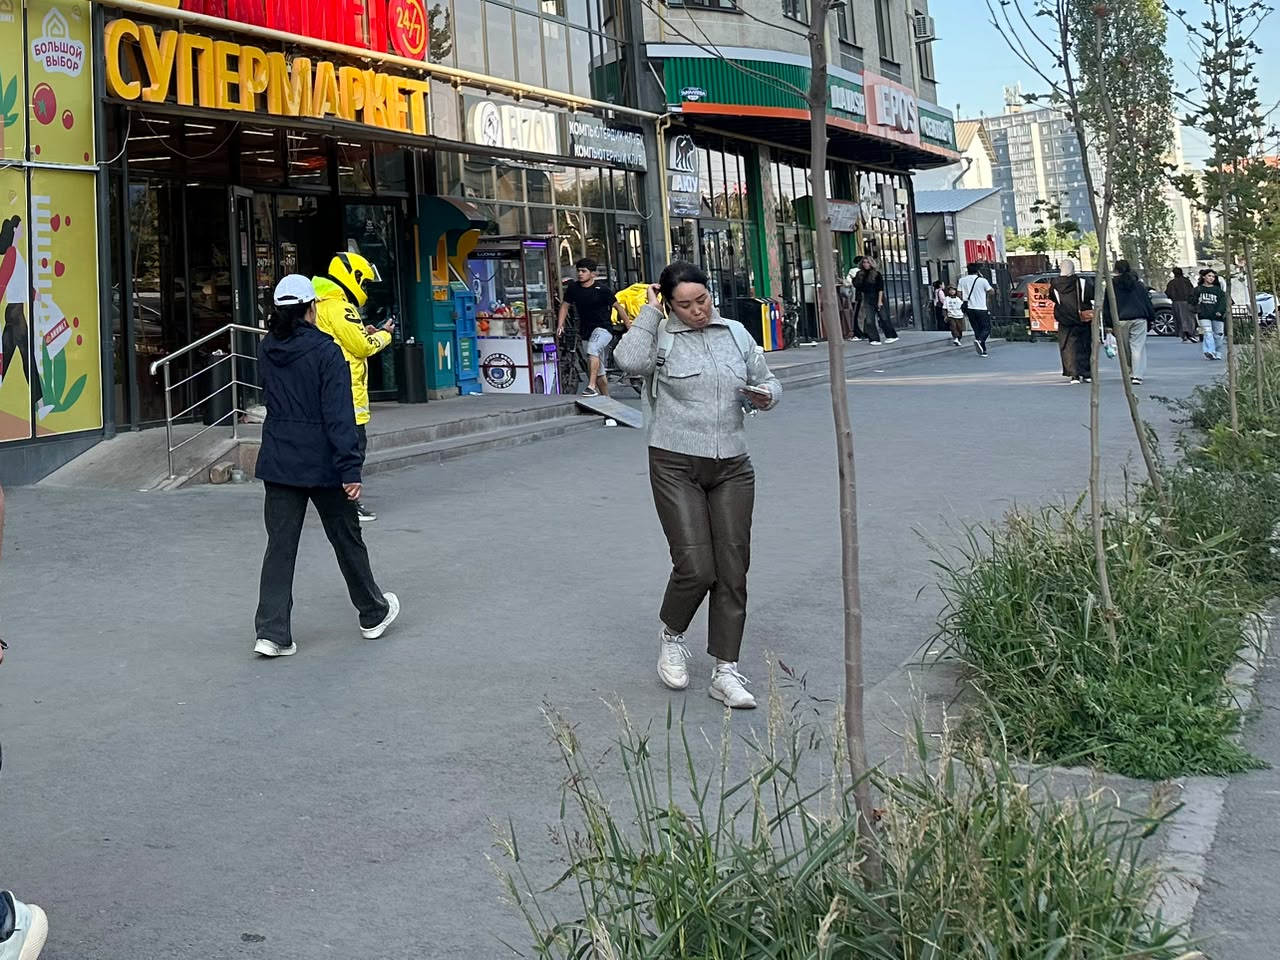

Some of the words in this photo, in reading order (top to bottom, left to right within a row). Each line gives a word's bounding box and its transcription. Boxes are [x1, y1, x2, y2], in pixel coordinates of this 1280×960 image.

[396, 6, 421, 45] 24/7
[34, 41, 83, 61] БОЛЬШОЙ
[45, 55, 79, 72] ВЫБОР
[104, 18, 429, 136] СУПЕРМАРКЕТ
[875, 84, 916, 133] EPOS
